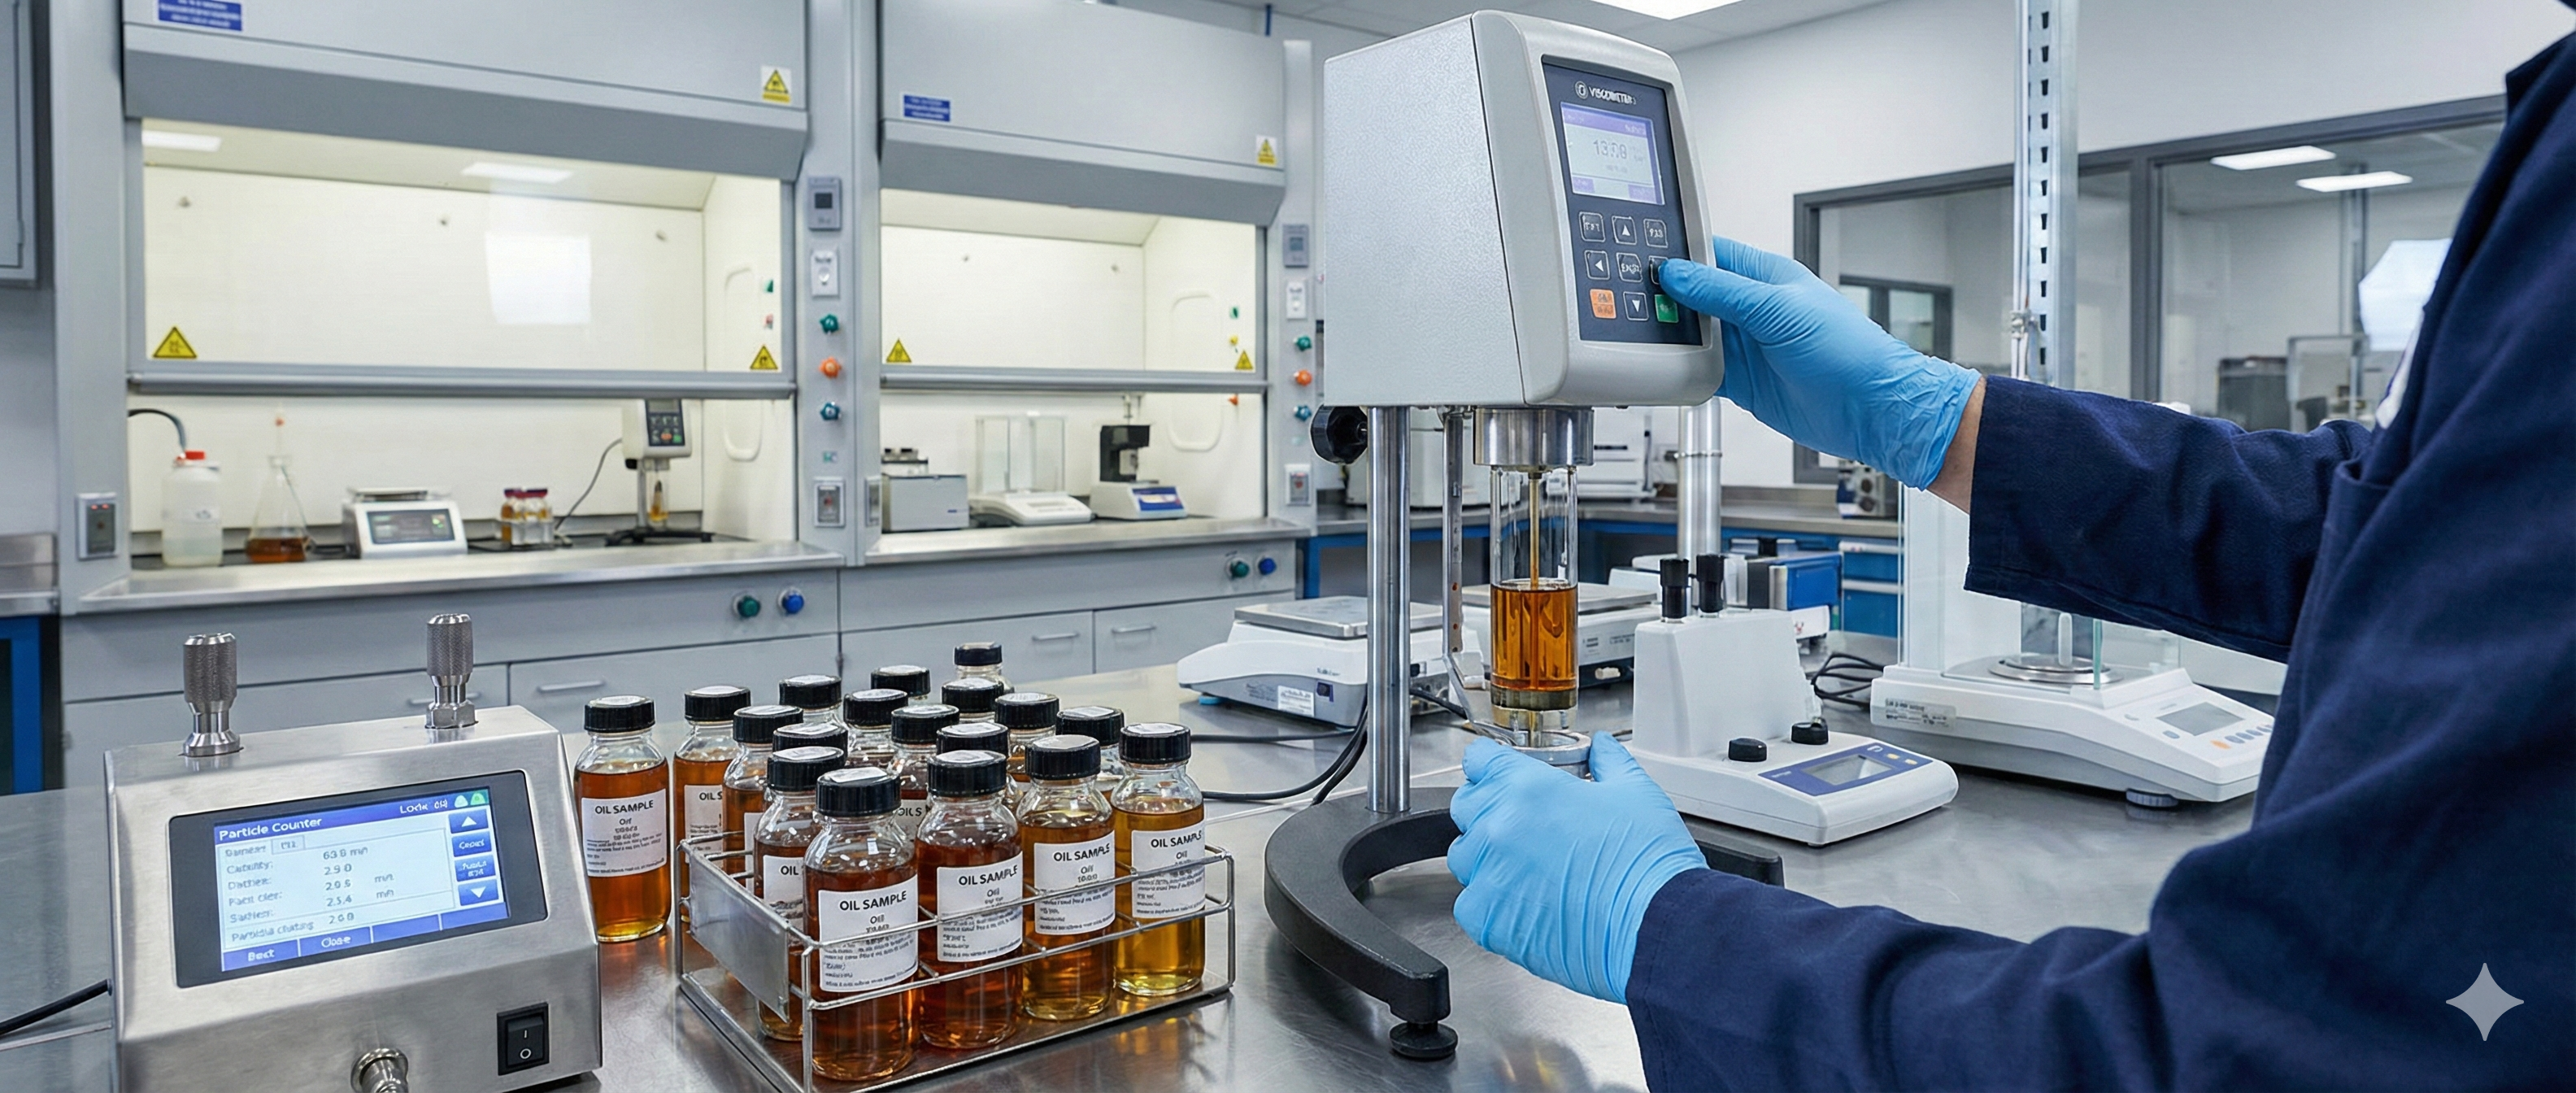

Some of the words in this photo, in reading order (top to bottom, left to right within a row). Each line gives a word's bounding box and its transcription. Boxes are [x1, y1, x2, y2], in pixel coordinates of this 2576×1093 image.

[699, 792, 716, 801] OIL
[594, 805, 611, 814] OIL
[613, 799, 654, 814] SAMPLE
[219, 825, 269, 841] Particle
[272, 818, 322, 833] Counter
[1151, 838, 1168, 847] OIL
[1053, 851, 1073, 862] OIL
[780, 865, 799, 876] OIL
[959, 875, 978, 886] OIL
[979, 864, 1018, 885] SAMPLE
[839, 900, 860, 911] OIL
[863, 890, 907, 910] SAMPLE
